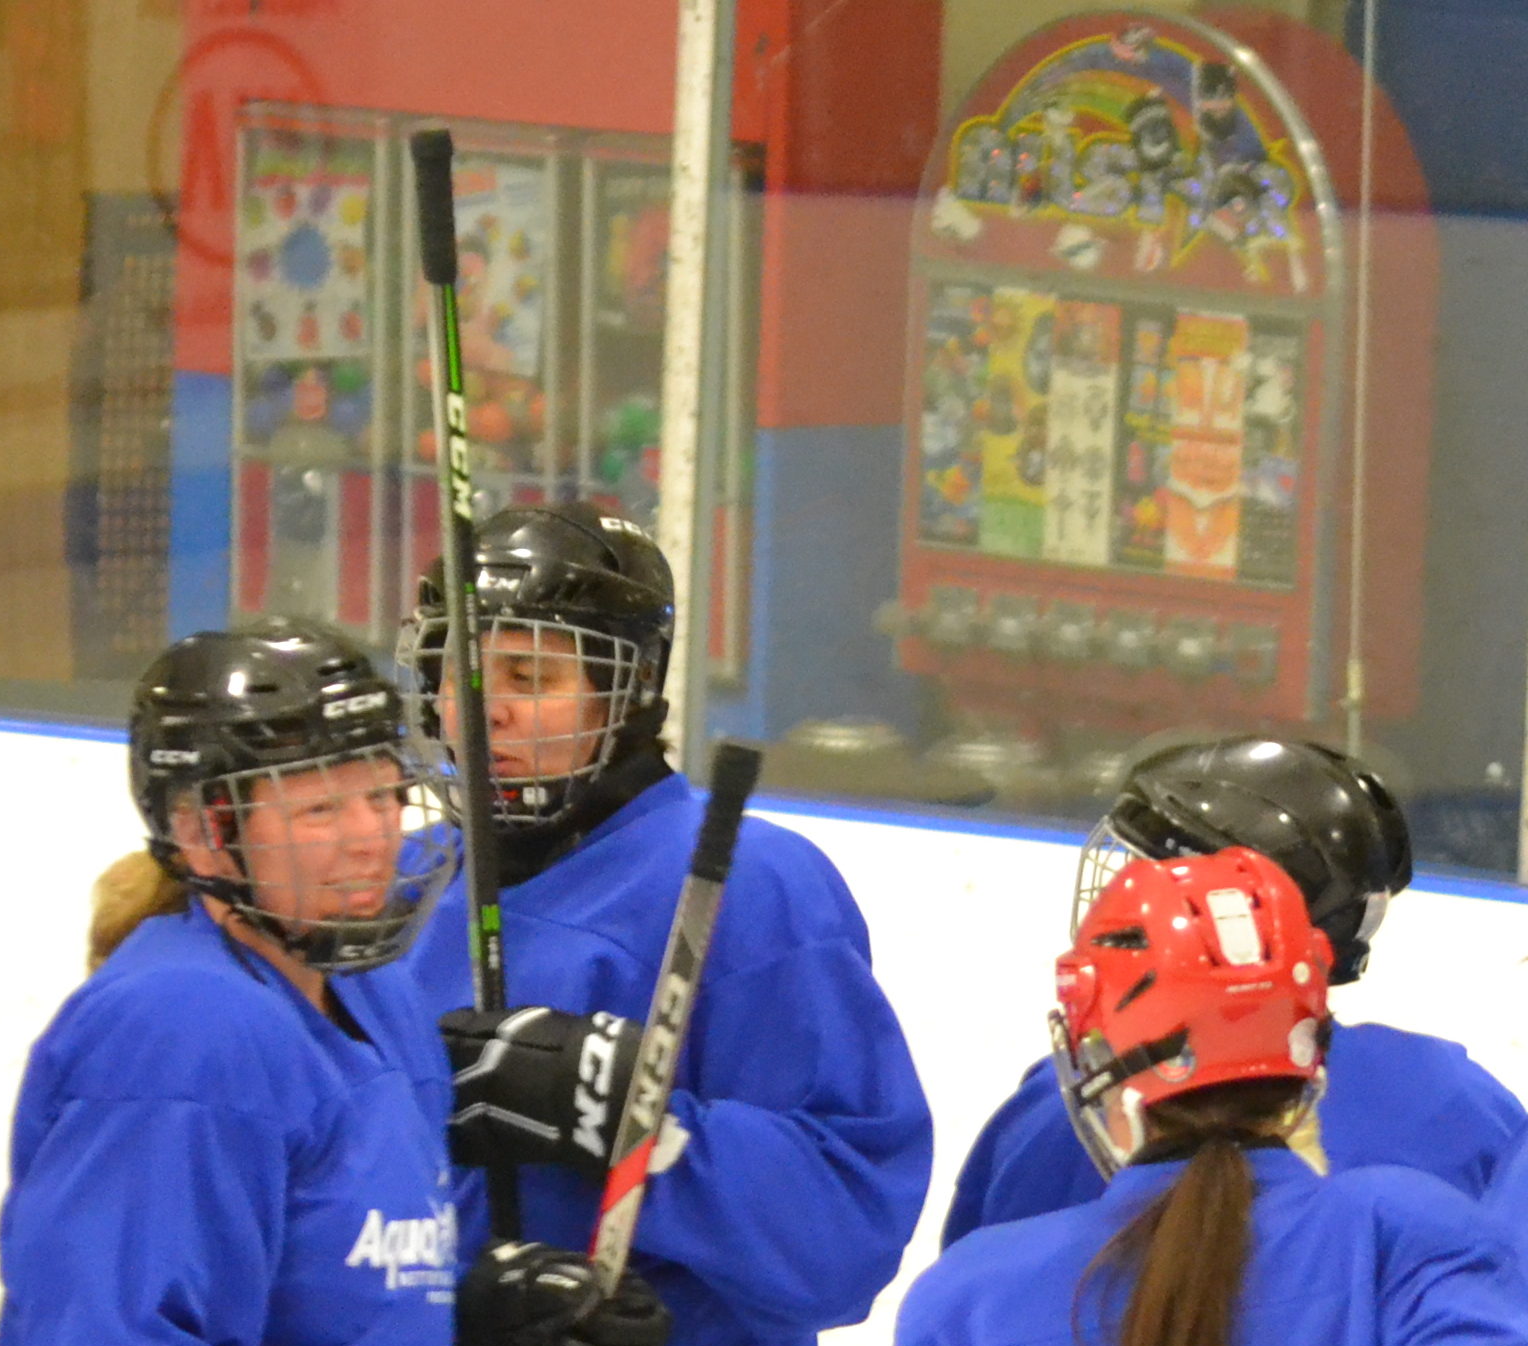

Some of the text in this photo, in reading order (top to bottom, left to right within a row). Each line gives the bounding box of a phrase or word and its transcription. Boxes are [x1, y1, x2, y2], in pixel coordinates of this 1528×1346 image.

[448, 393, 473, 520] CCM
[599, 517, 653, 541] CC
[322, 690, 388, 720] CCM
[630, 972, 686, 1130] CCM
